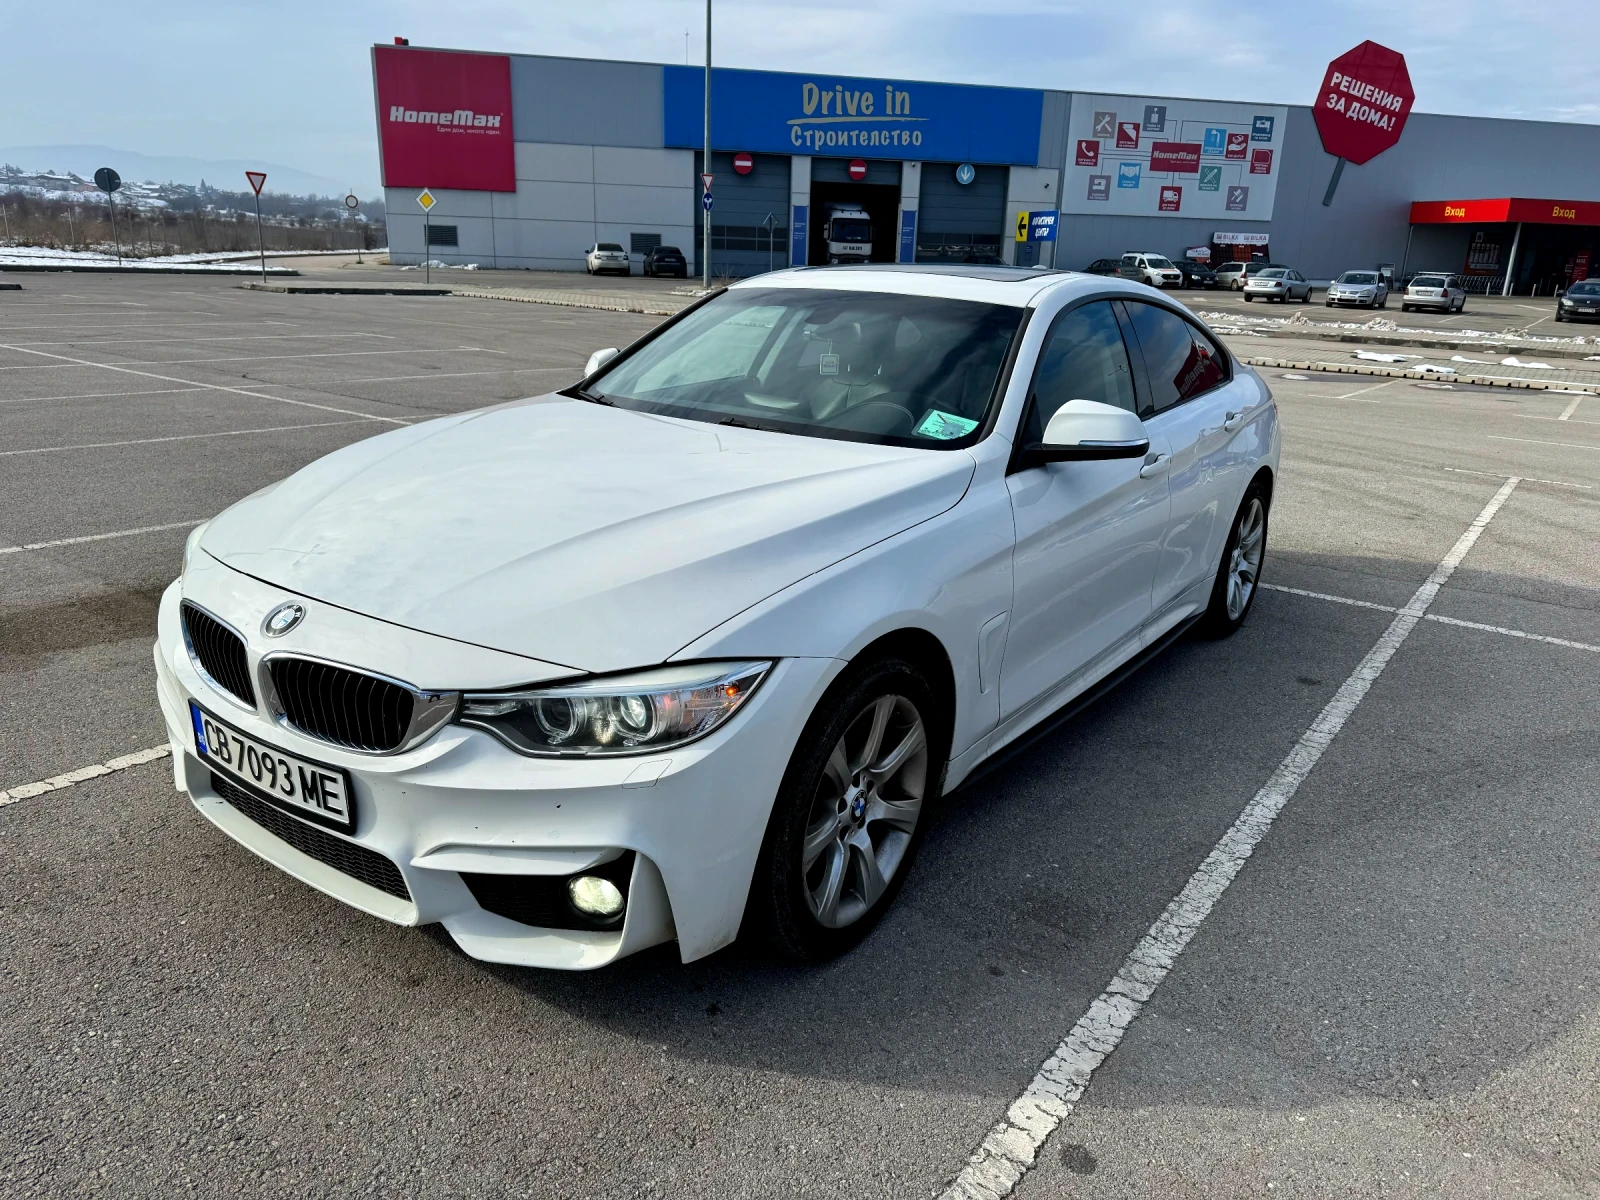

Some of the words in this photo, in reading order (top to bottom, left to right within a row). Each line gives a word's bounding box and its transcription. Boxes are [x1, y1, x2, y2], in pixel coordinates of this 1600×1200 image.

[802, 82, 874, 116] Drive
[885, 85, 910, 115] in
[1330, 72, 1403, 112] РЕШЕНИЯ
[389, 106, 501, 127] HomeMax
[1326, 93, 1345, 113] ЗА
[1346, 104, 1396, 131] ДОМА!
[437, 125, 452, 134] Един
[790, 125, 922, 151] Строителство
[1444, 206, 1466, 218] Вход
[1552, 206, 1576, 219] Вход
